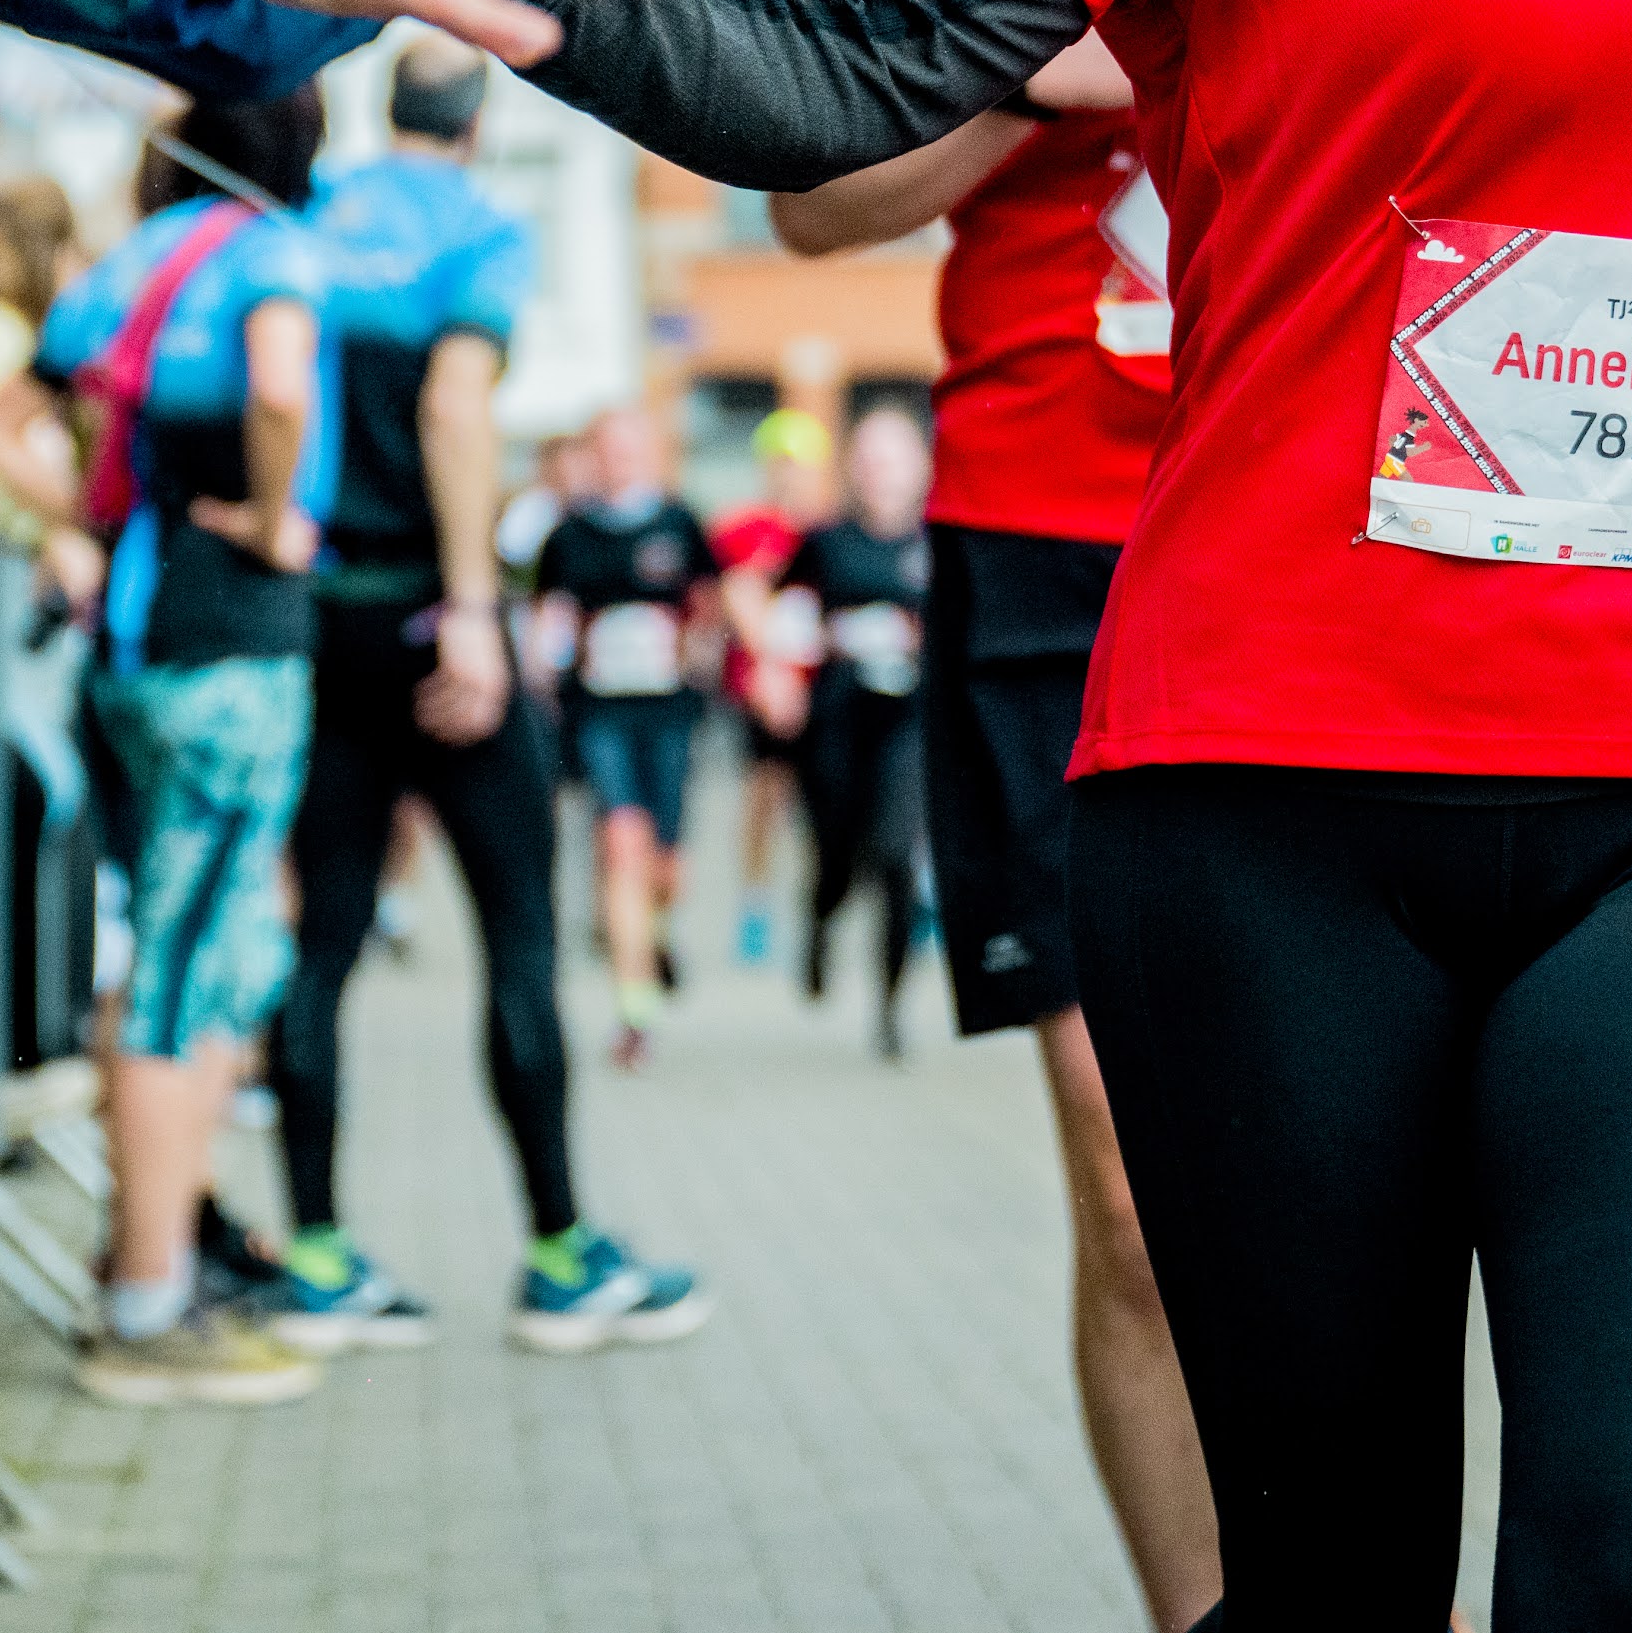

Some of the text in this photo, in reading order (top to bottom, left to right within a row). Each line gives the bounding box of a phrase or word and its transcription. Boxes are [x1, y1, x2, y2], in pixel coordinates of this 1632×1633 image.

[1396, 231, 1530, 342] 2024 2024 2024 2024 2024 2024 2024
[1390, 340, 1405, 360] 2024
[1401, 358, 1419, 380] 2024
[1415, 378, 1434, 399] 2024
[1430, 398, 1449, 419] 2024
[1445, 417, 1464, 439] 2024
[1460, 437, 1478, 458] 2024
[1475, 456, 1493, 478] 2024
[1513, 545, 1538, 553] HALLE
[1573, 549, 1607, 559] euroclear
